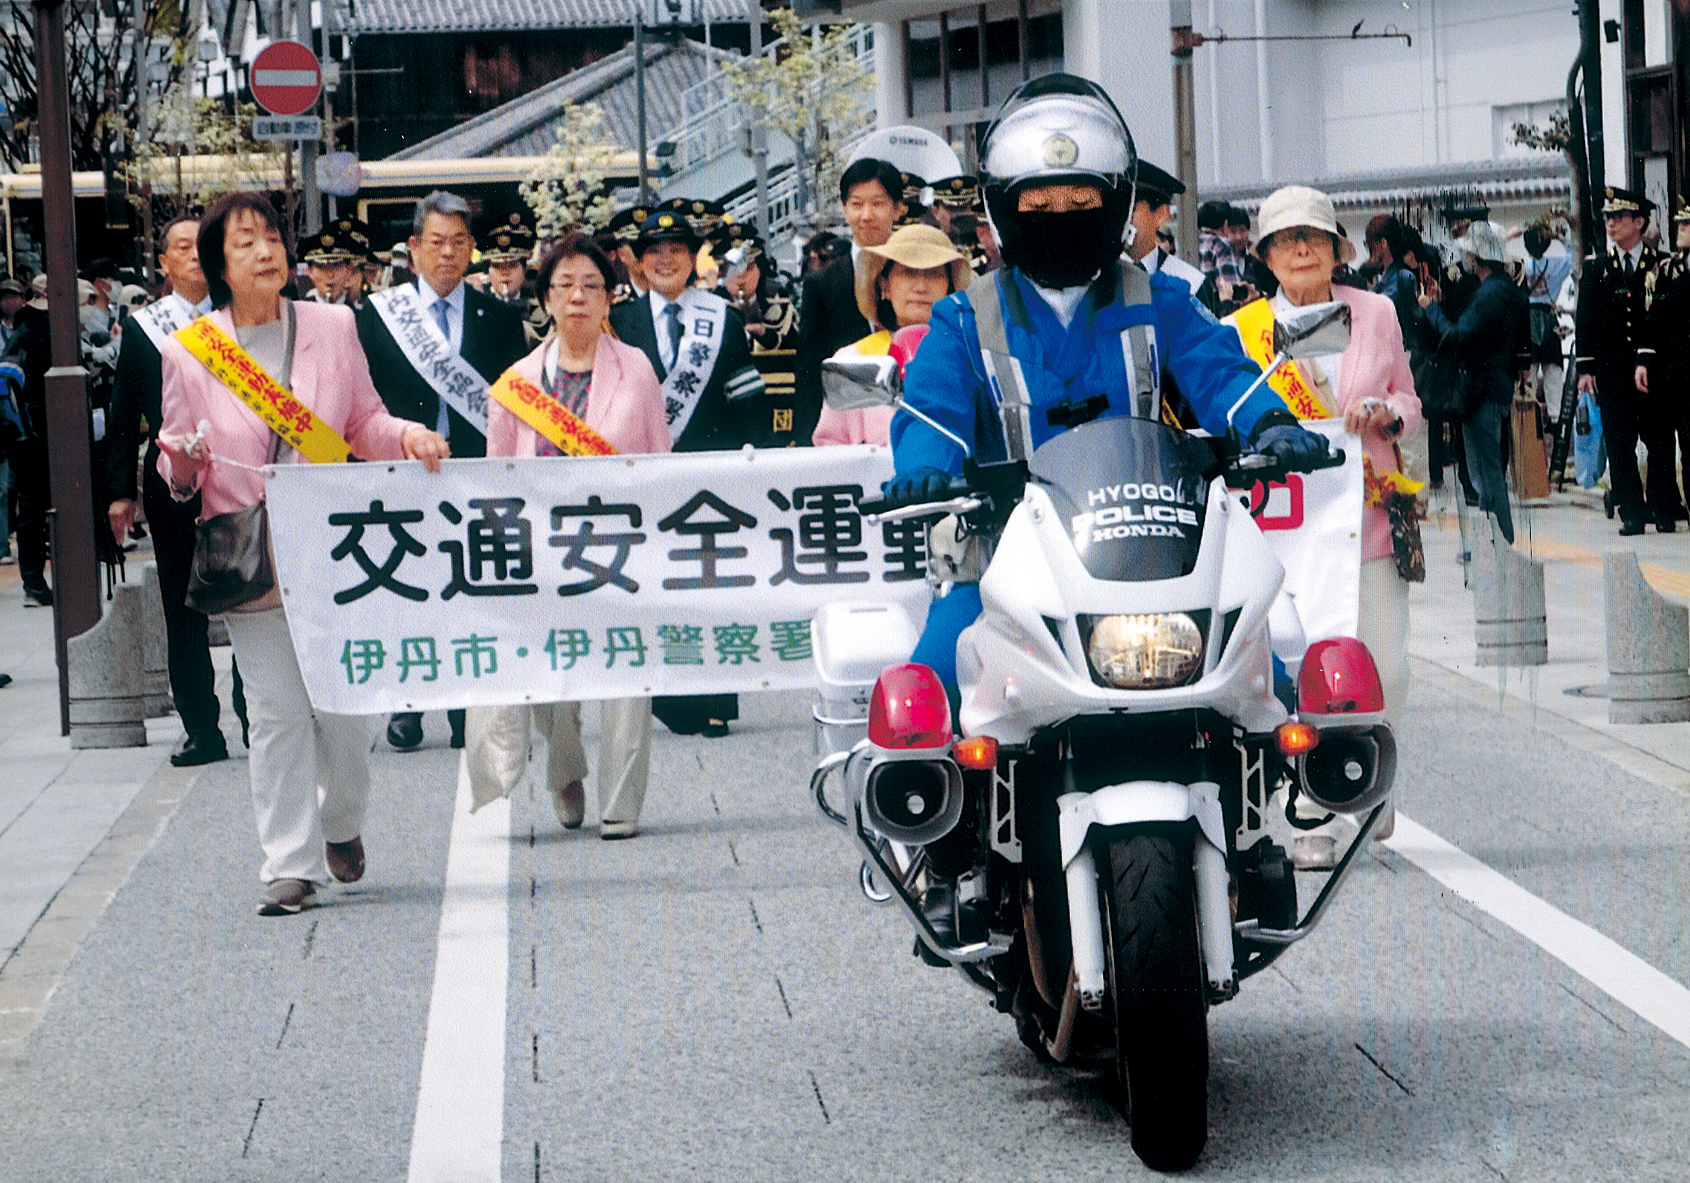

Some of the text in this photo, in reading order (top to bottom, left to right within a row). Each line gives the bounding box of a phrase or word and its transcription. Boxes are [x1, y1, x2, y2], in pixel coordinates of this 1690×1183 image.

[1087, 483, 1176, 507] HYOGO
[1071, 505, 1199, 536] POLICE
[1092, 524, 1186, 542] HONDA
